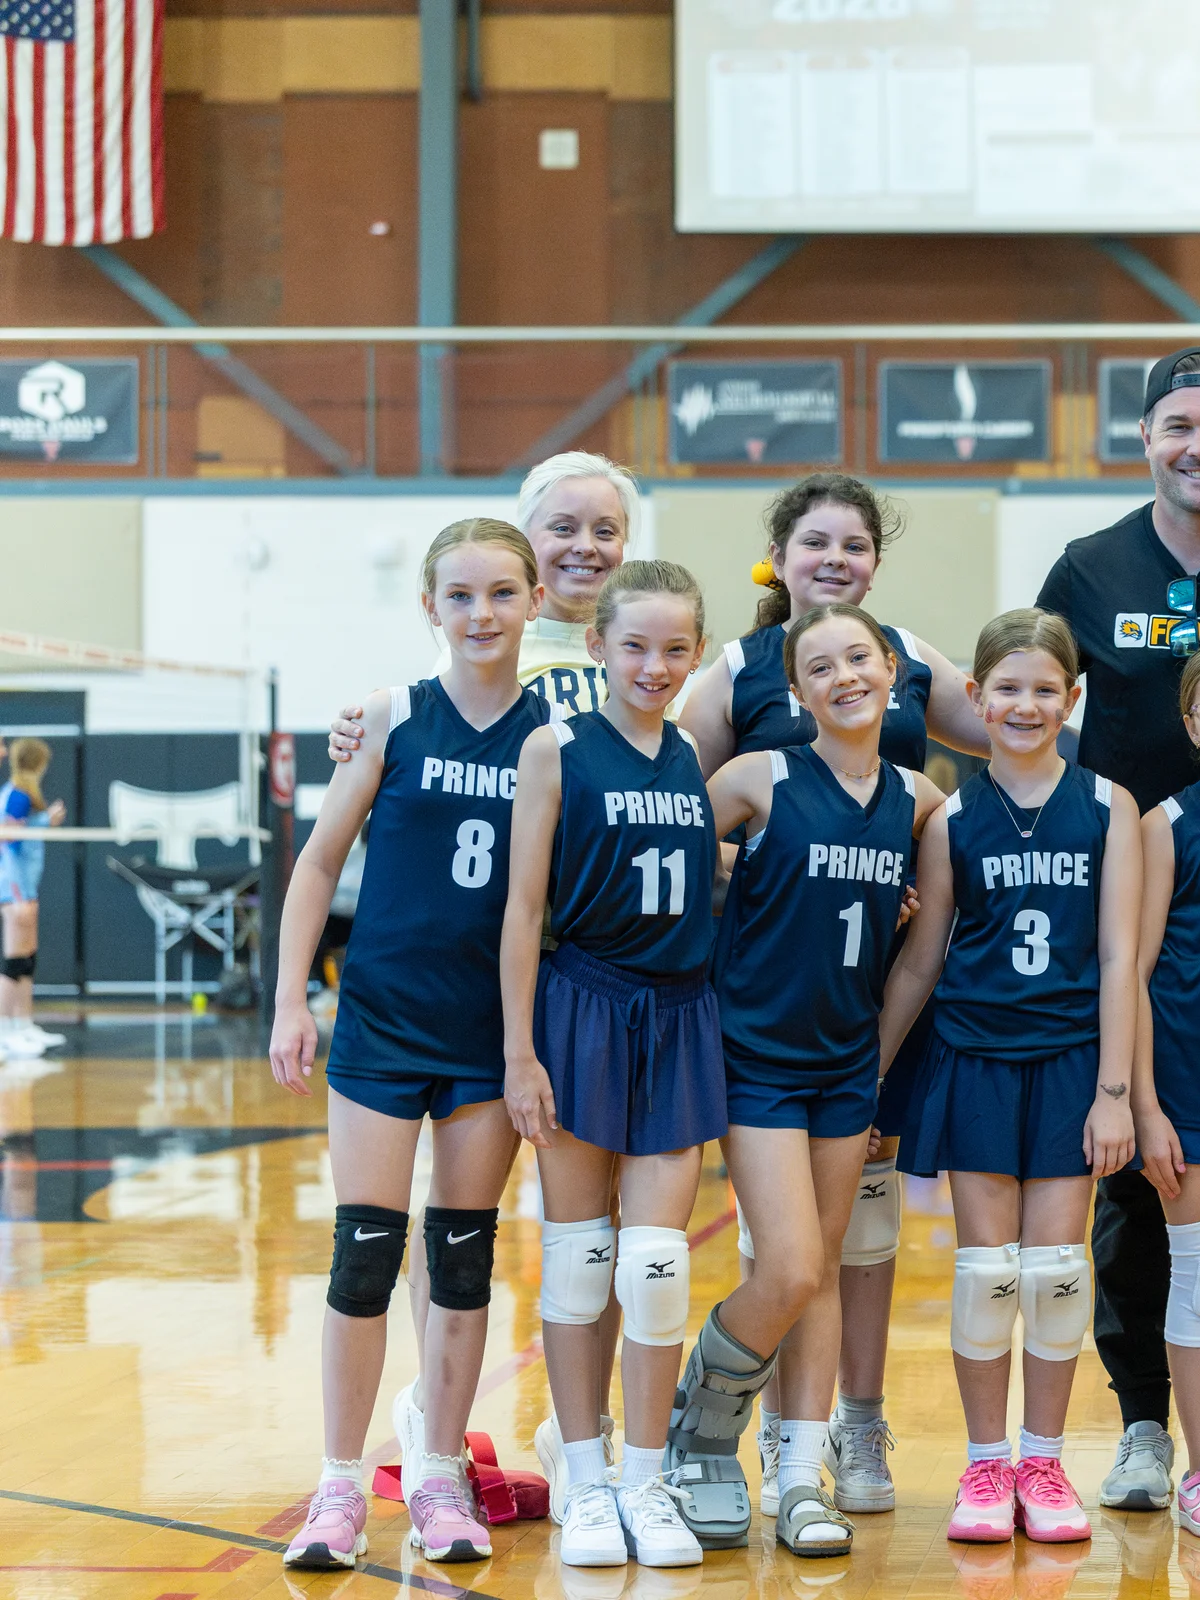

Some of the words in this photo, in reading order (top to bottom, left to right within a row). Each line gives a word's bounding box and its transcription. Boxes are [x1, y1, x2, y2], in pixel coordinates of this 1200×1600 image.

[524, 668, 608, 714] RI
[421, 757, 518, 800] PRINC
[604, 791, 705, 827] PRINCE
[451, 819, 495, 888] 8
[808, 844, 904, 886] PRINCE
[982, 851, 1090, 890] PRINCE
[632, 848, 686, 915] 11
[838, 902, 863, 967] 1
[1012, 909, 1051, 976] 3
